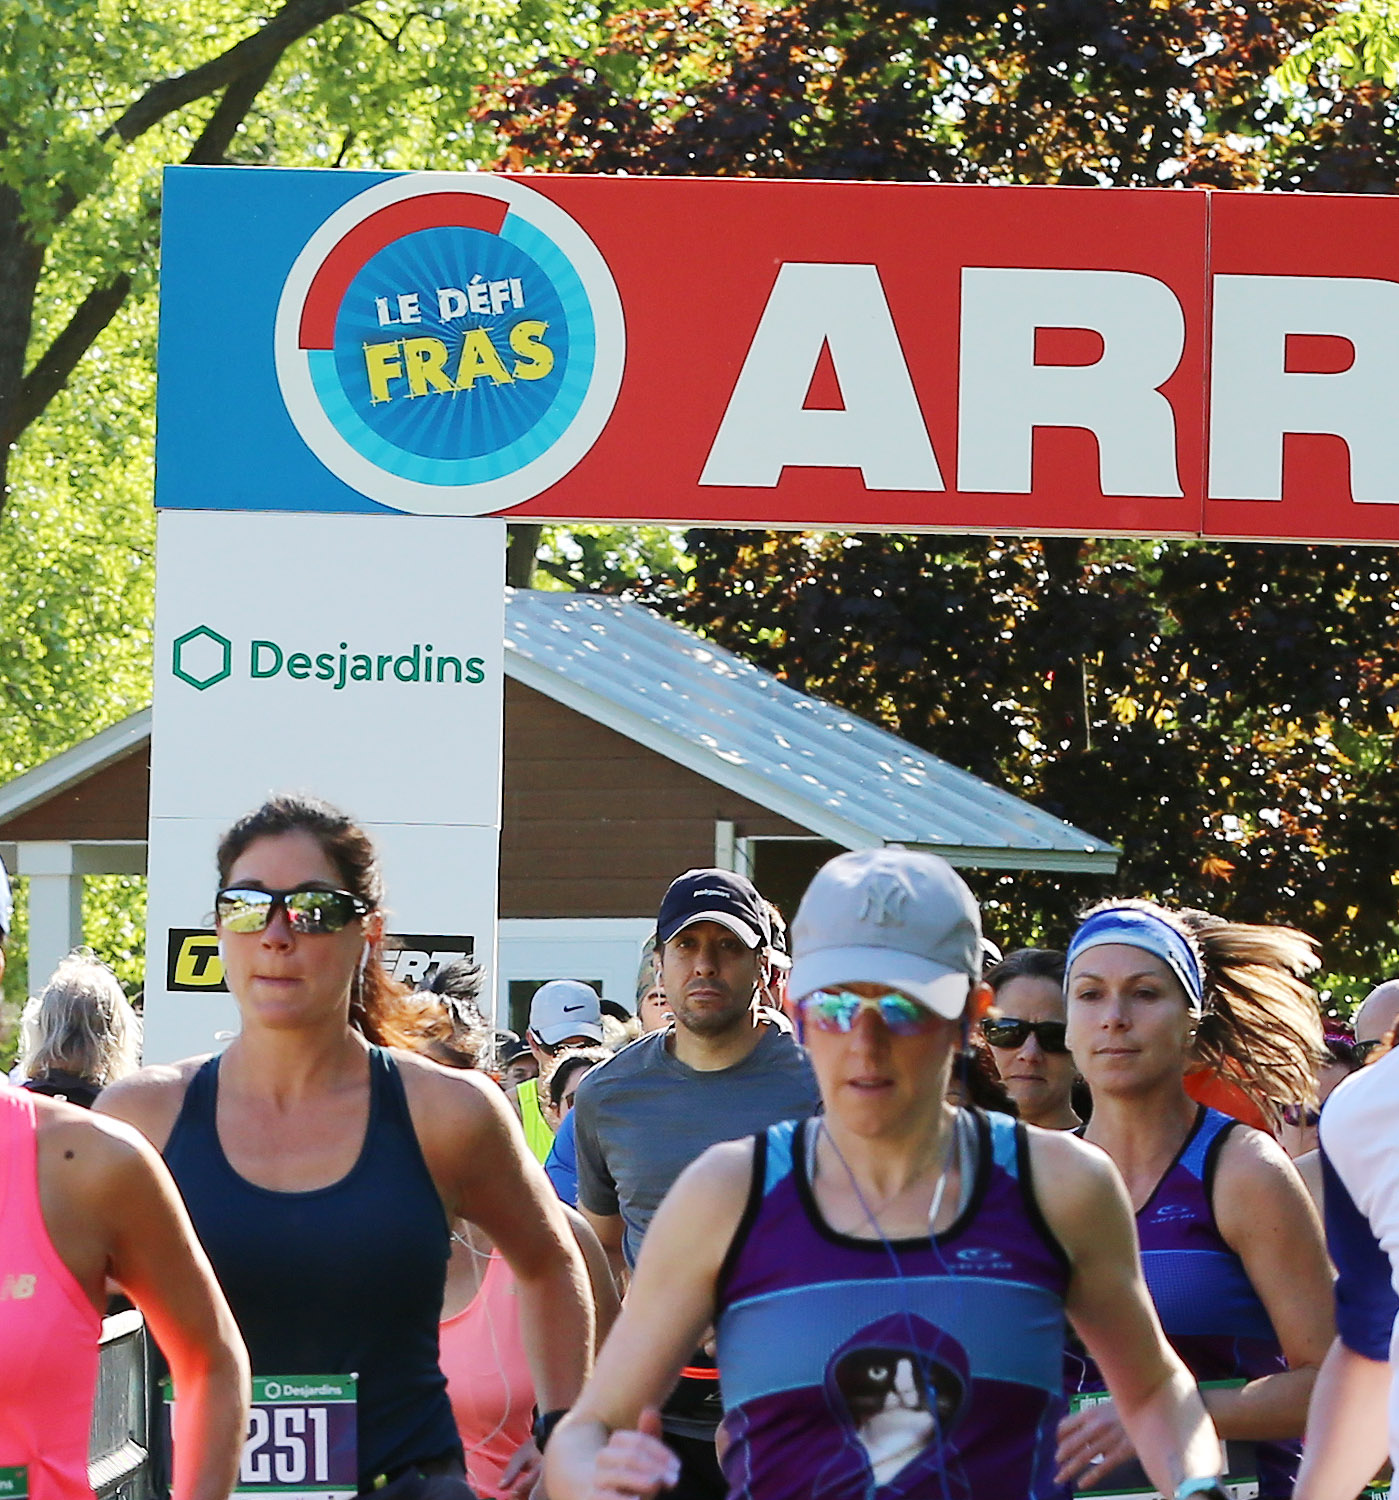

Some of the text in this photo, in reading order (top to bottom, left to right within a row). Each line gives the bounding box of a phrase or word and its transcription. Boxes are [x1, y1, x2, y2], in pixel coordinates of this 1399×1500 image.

[375, 274, 525, 326] LE DÉFI
[362, 320, 555, 407] FRAS
[250, 640, 485, 690] Desjardins
[283, 1384, 342, 1397] Desjardins
[240, 1408, 328, 1483] 251
